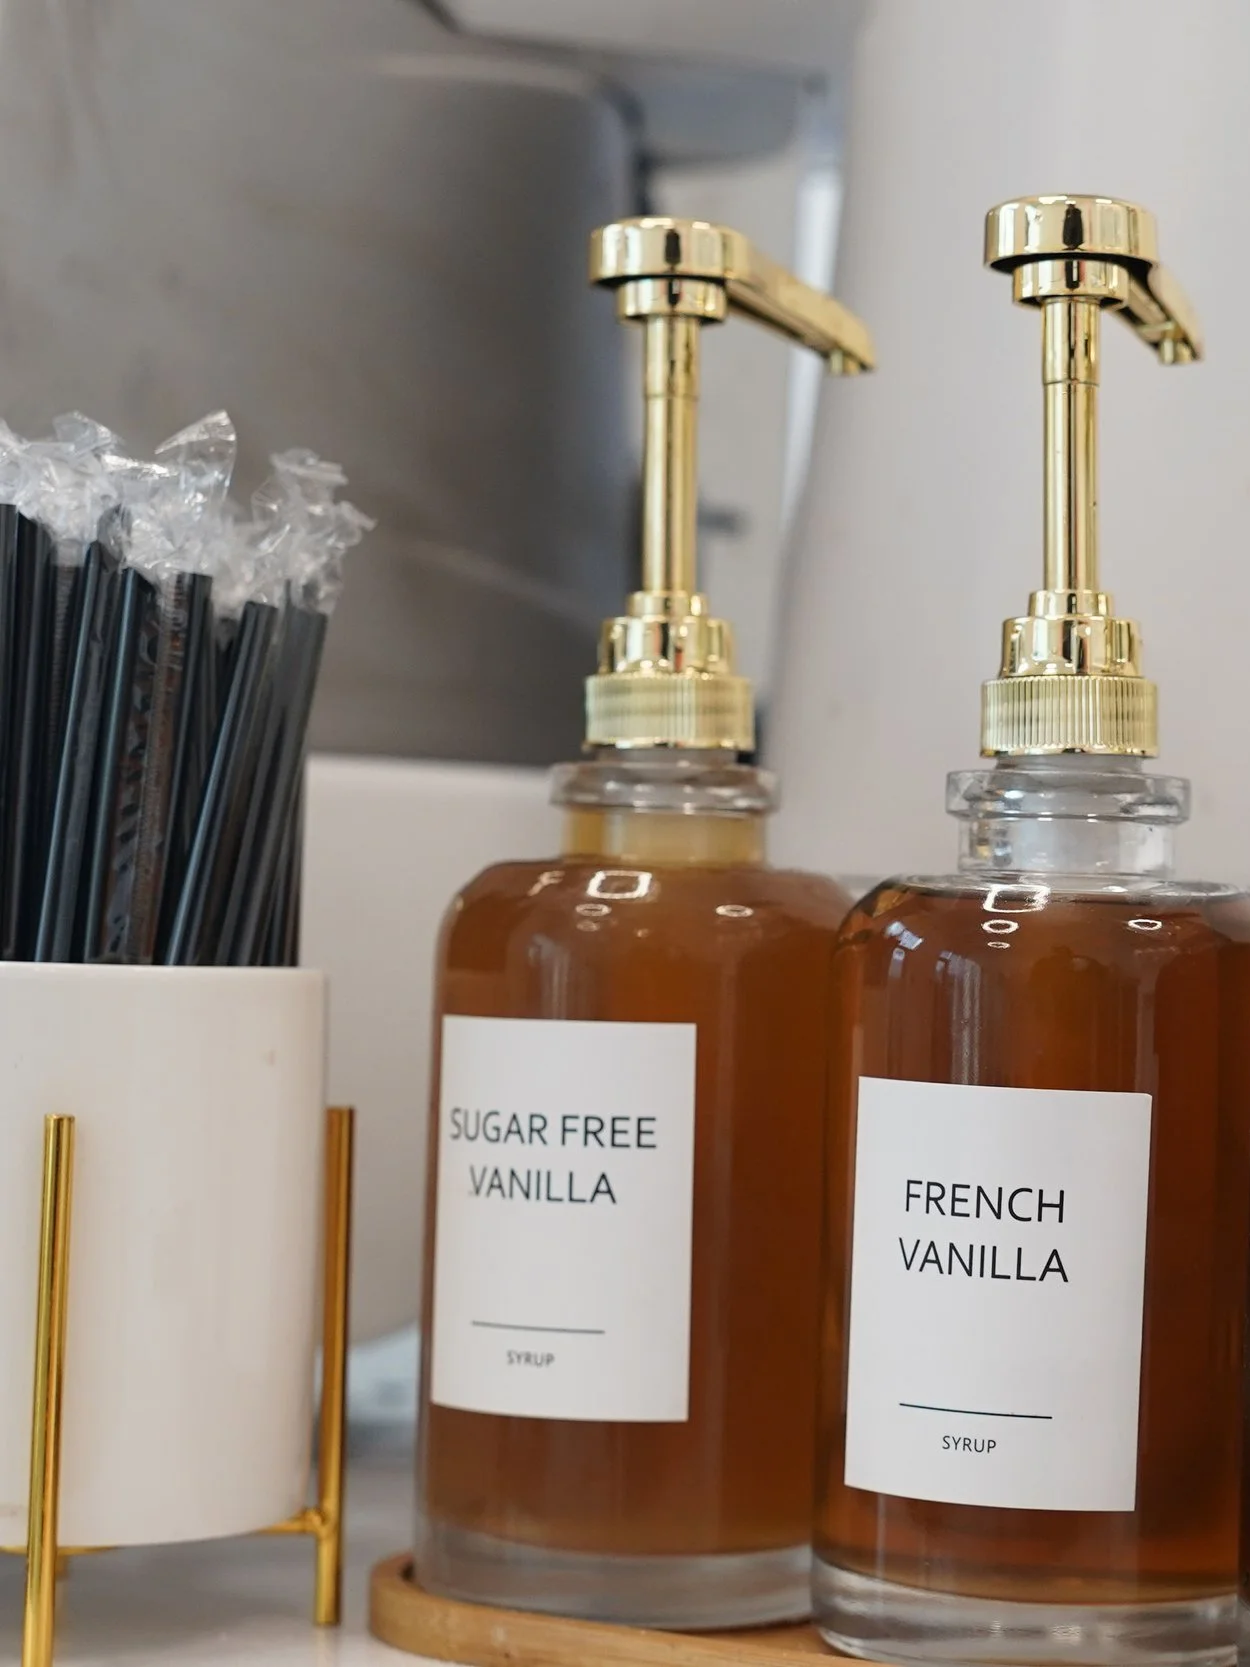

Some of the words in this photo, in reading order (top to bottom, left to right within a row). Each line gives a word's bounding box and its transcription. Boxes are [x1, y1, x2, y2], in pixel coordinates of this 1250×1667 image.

[450, 1107, 548, 1146] SUGAR
[561, 1114, 657, 1150] FREE
[470, 1166, 617, 1205] VANILLA
[905, 1179, 1065, 1224] FRENCH
[898, 1236, 1069, 1284] VANILLA
[507, 1350, 554, 1368] SYRUP
[941, 1435, 997, 1455] SYRUP
